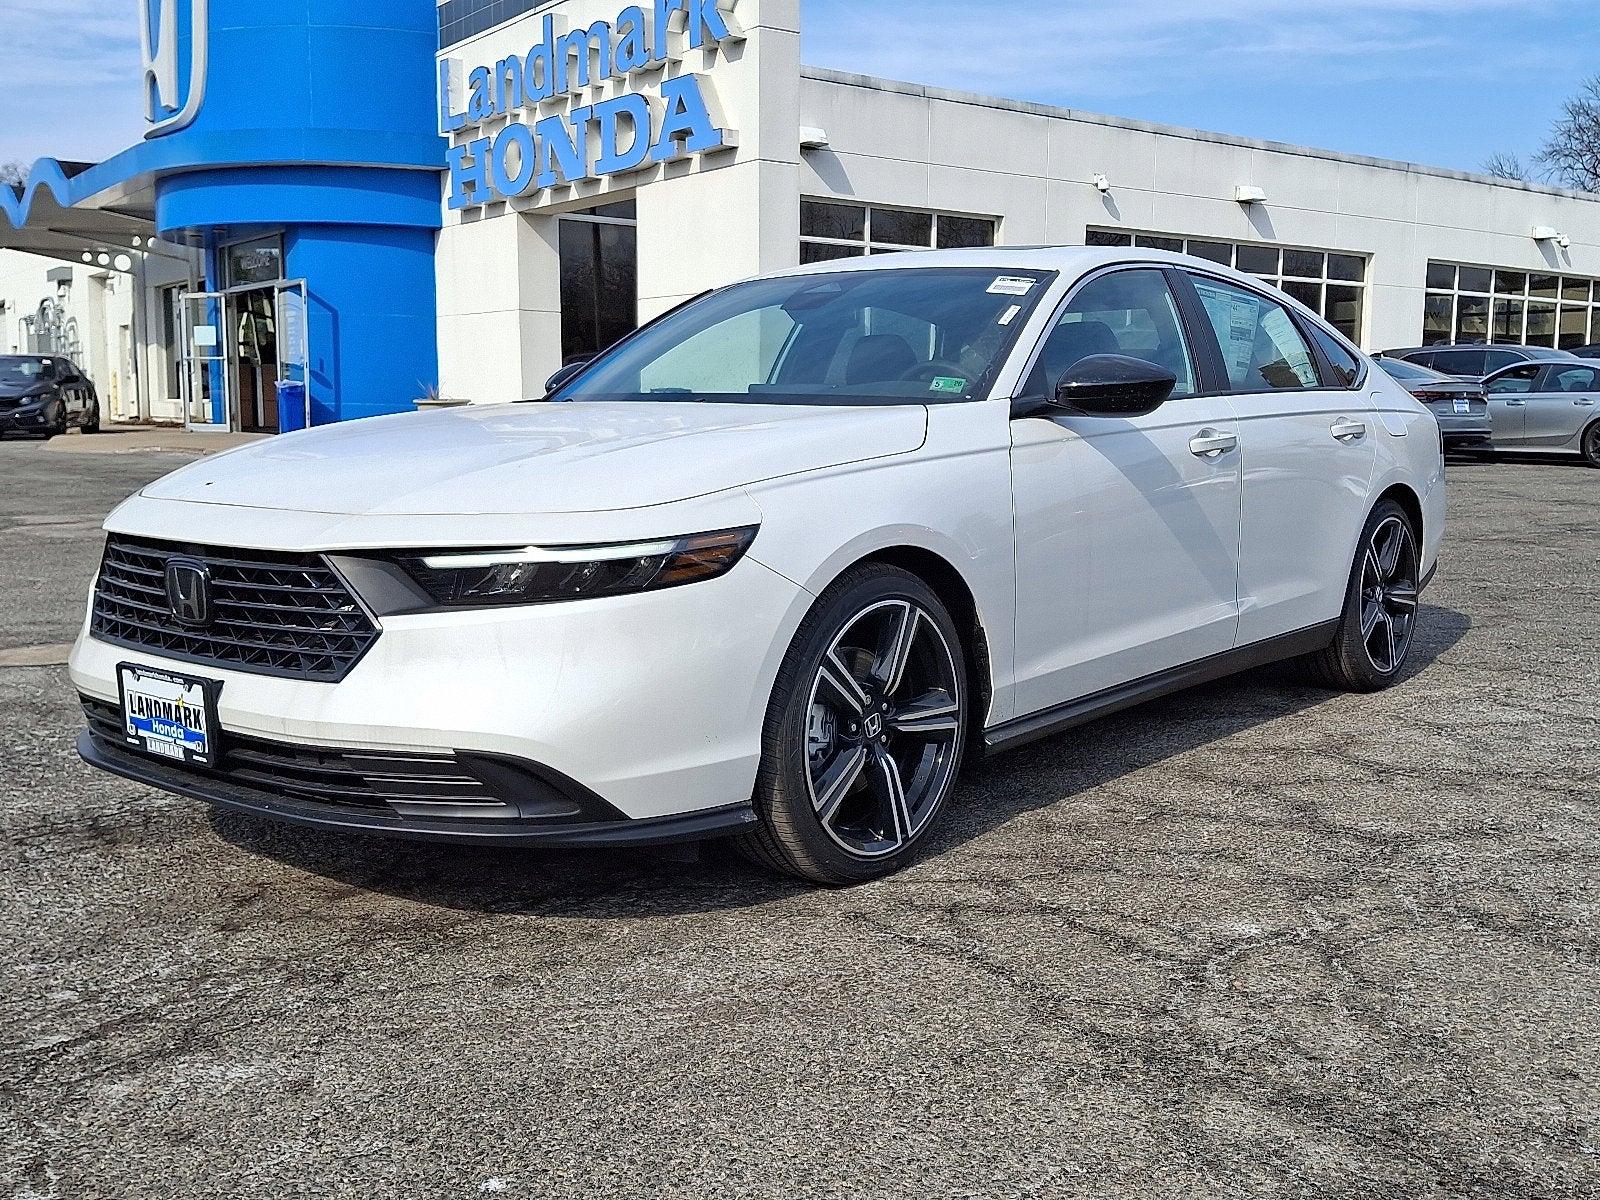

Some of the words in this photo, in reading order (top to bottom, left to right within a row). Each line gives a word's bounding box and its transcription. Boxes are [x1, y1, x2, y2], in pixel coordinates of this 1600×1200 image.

[441, 0, 732, 134] Landmark
[446, 73, 722, 210] HONDA
[128, 692, 203, 731] LANDMARK
[152, 720, 185, 739] Honda
[147, 737, 185, 760] LANDMARK
